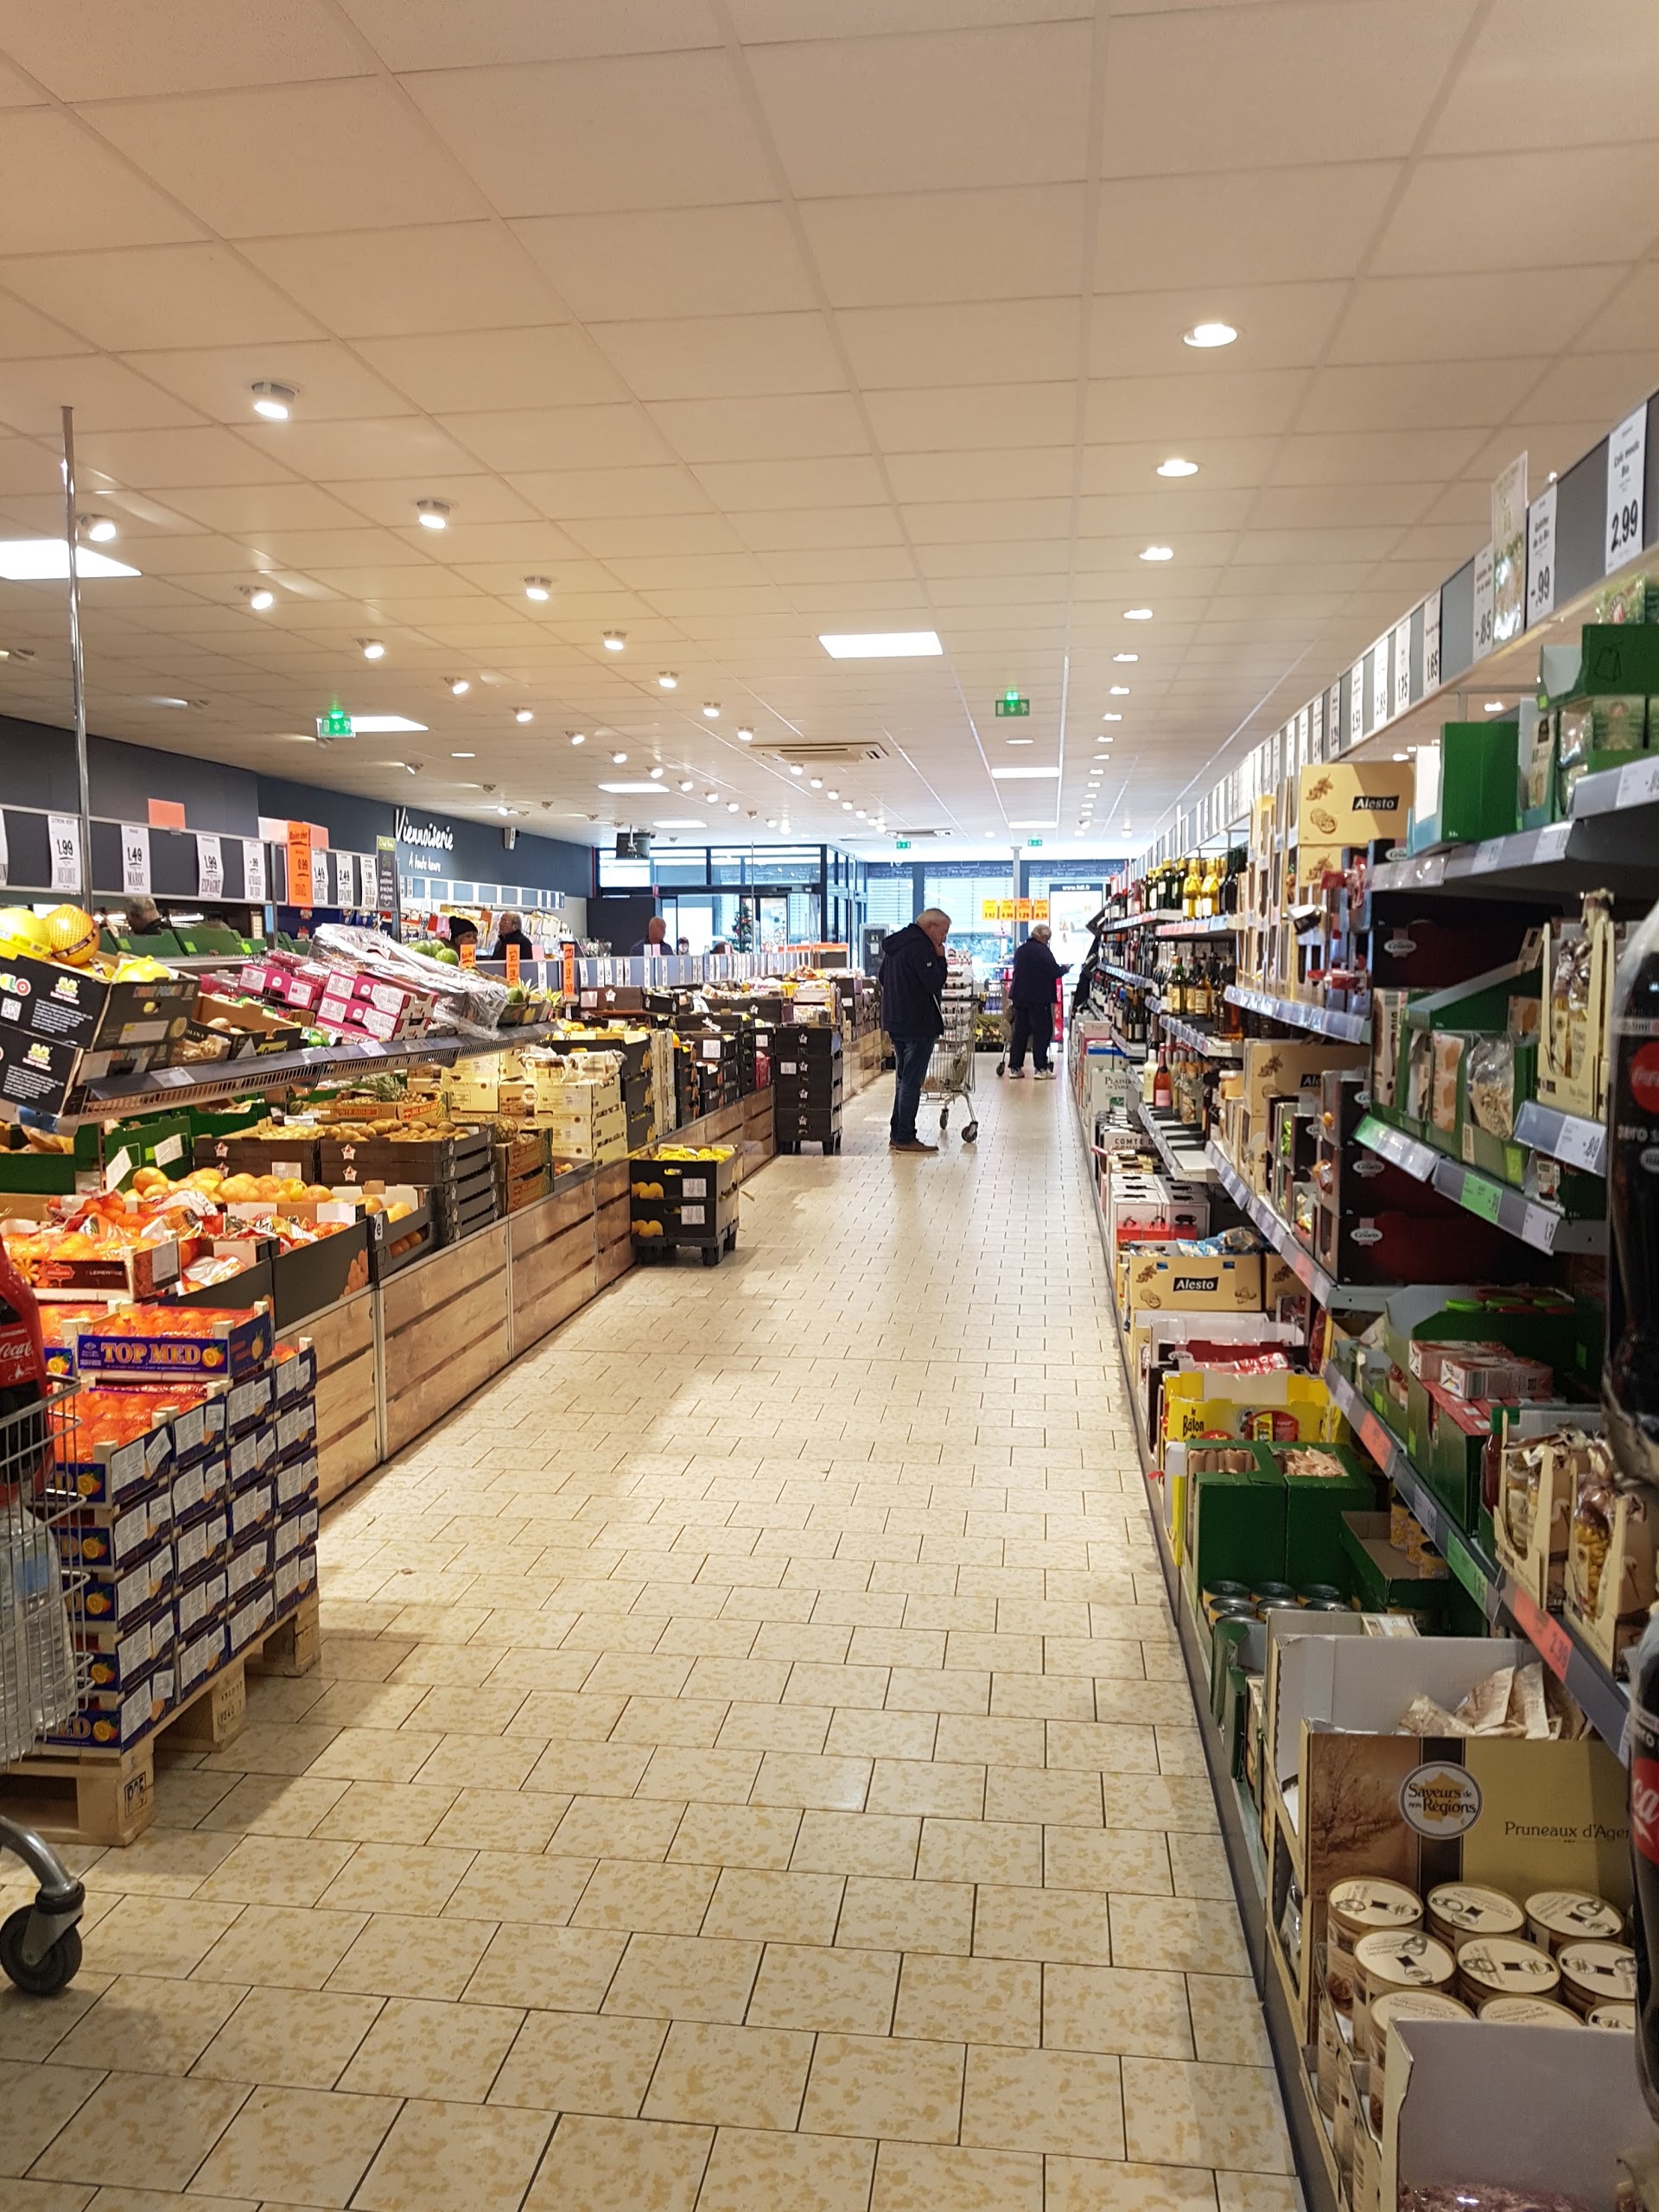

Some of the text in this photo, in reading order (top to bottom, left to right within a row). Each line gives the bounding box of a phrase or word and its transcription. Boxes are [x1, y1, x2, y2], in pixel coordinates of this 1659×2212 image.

[1355, 798, 1395, 810] Alesto
[396, 806, 454, 851] Viennoiserie
[57, 838, 73, 856] 1.99
[127, 847, 143, 862] 1.49
[1175, 1278, 1215, 1291] Alesto
[100, 1341, 148, 1364] TOP
[148, 1343, 201, 1366] MED
[1182, 1414, 1205, 1438] Bâton
[1408, 1782, 1462, 1799] Saveurs
[1422, 1797, 1477, 1816] Régions
[1504, 1821, 1578, 1839] Pruneaux
